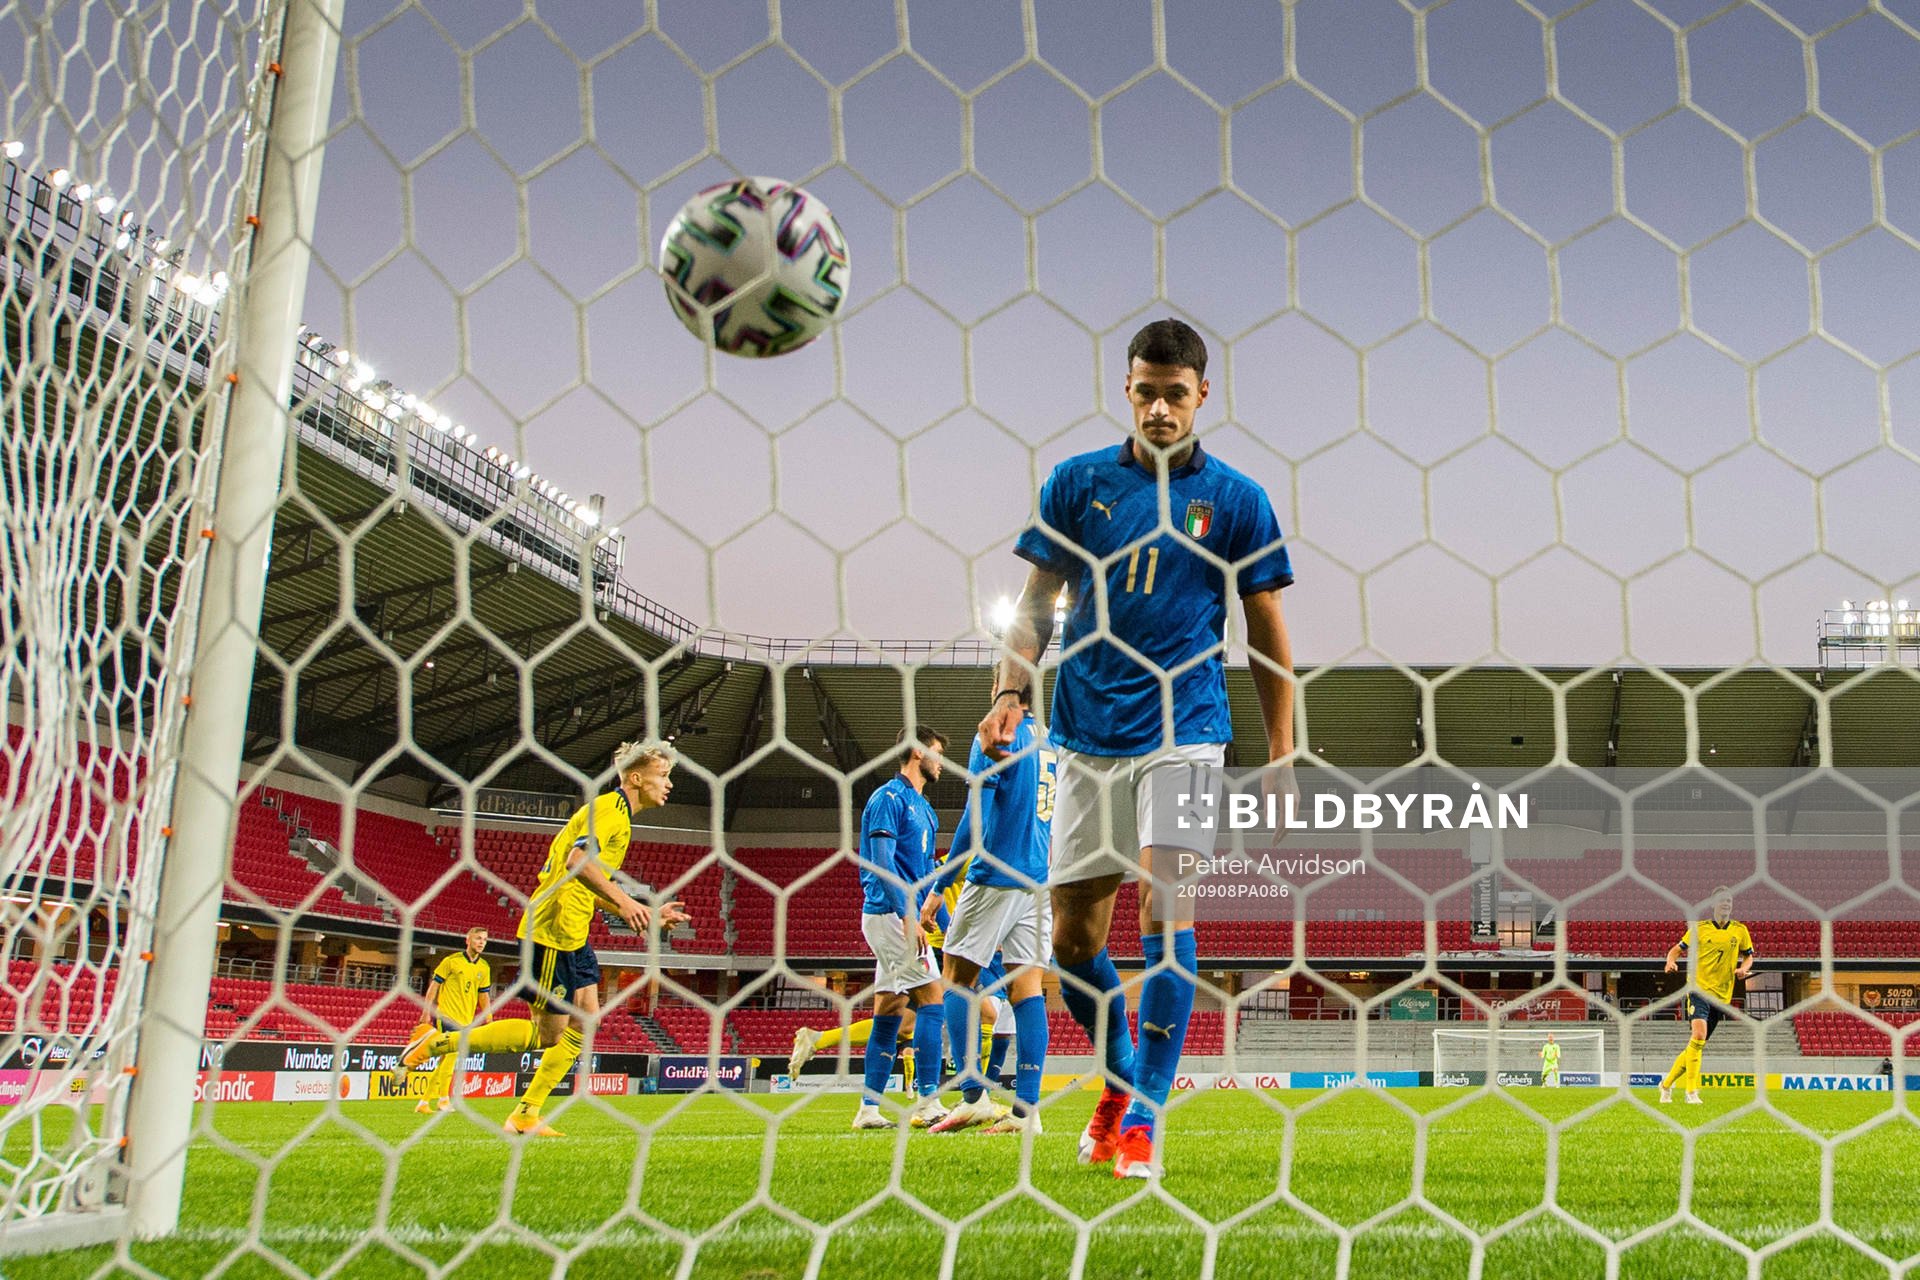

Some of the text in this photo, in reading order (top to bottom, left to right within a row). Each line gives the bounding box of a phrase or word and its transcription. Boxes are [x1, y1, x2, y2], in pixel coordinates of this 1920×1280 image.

[1126, 545, 1159, 594] 11
[1036, 749, 1057, 822] 5
[1717, 950, 1725, 963] 7
[465, 980, 471, 993] 9
[1887, 988, 1914, 998] 50/50
[1536, 1000, 1561, 1010] KFF!
[1883, 998, 1918, 1007] LOTTEN
[284, 1047, 334, 1069] Number
[361, 1050, 378, 1070] för
[665, 1066, 735, 1080] GuldFåeln
[485, 1074, 512, 1096] Estrella
[588, 1076, 624, 1092] AUHAUS
[1171, 1076, 1195, 1089] ICA
[1255, 1076, 1280, 1089] ICA
[1497, 1073, 1533, 1087] Carlsberg
[1701, 1075, 1755, 1087] HYLTE
[1783, 1077, 1883, 1090] MATAKI
[194, 1073, 255, 1101] Scandic
